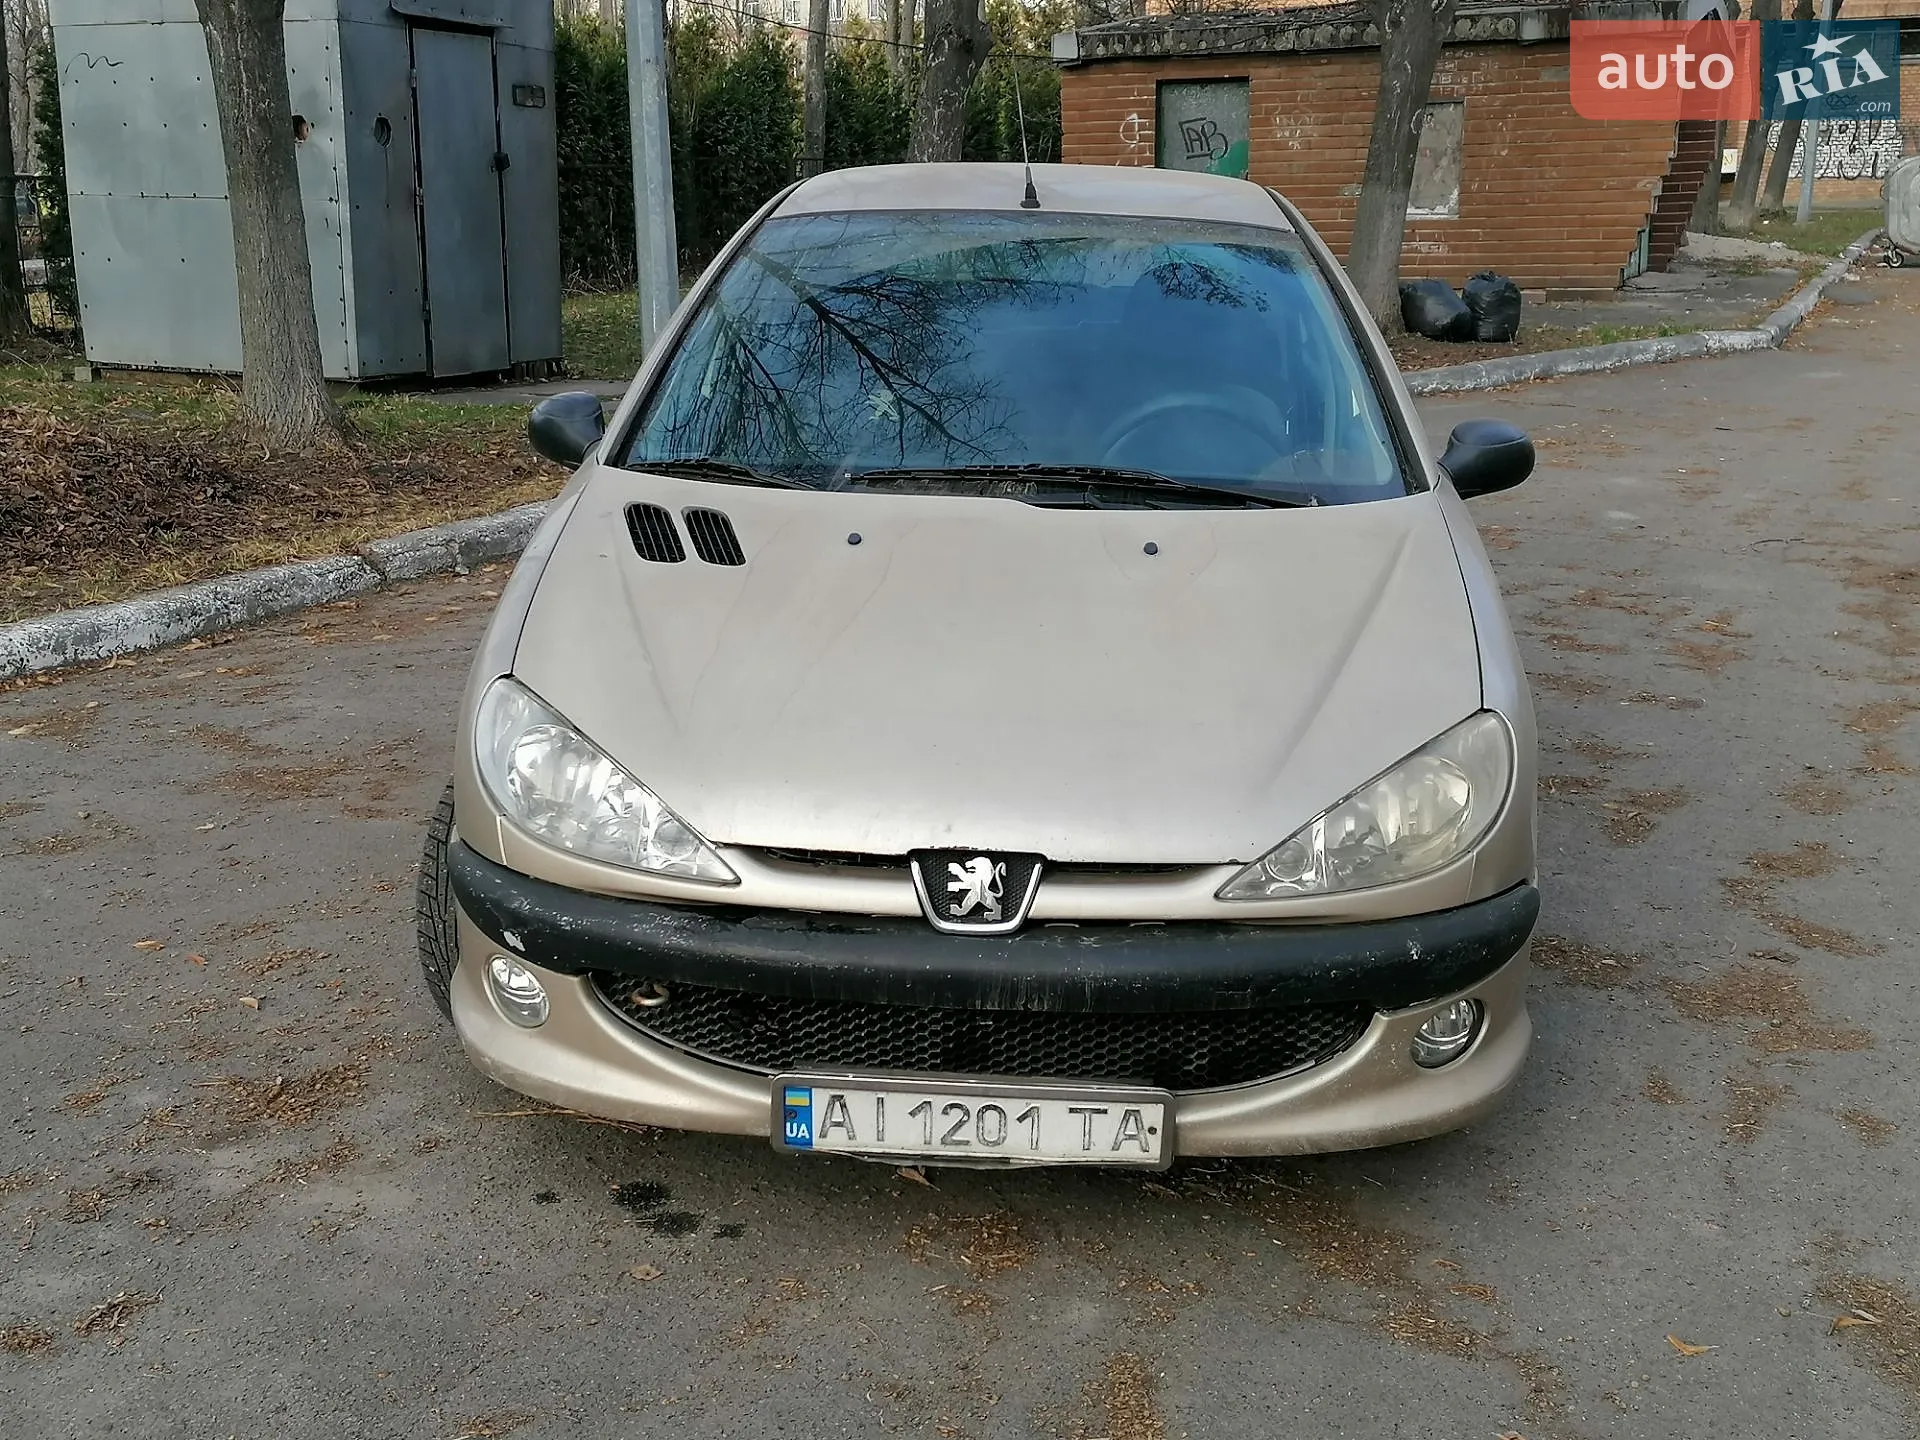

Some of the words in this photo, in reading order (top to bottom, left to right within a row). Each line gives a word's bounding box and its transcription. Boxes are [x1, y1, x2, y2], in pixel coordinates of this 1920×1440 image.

[785, 1121, 810, 1139] UA
[819, 1094, 886, 1142] AI
[908, 1100, 1041, 1150] 1201
[1069, 1107, 1150, 1153] TA
